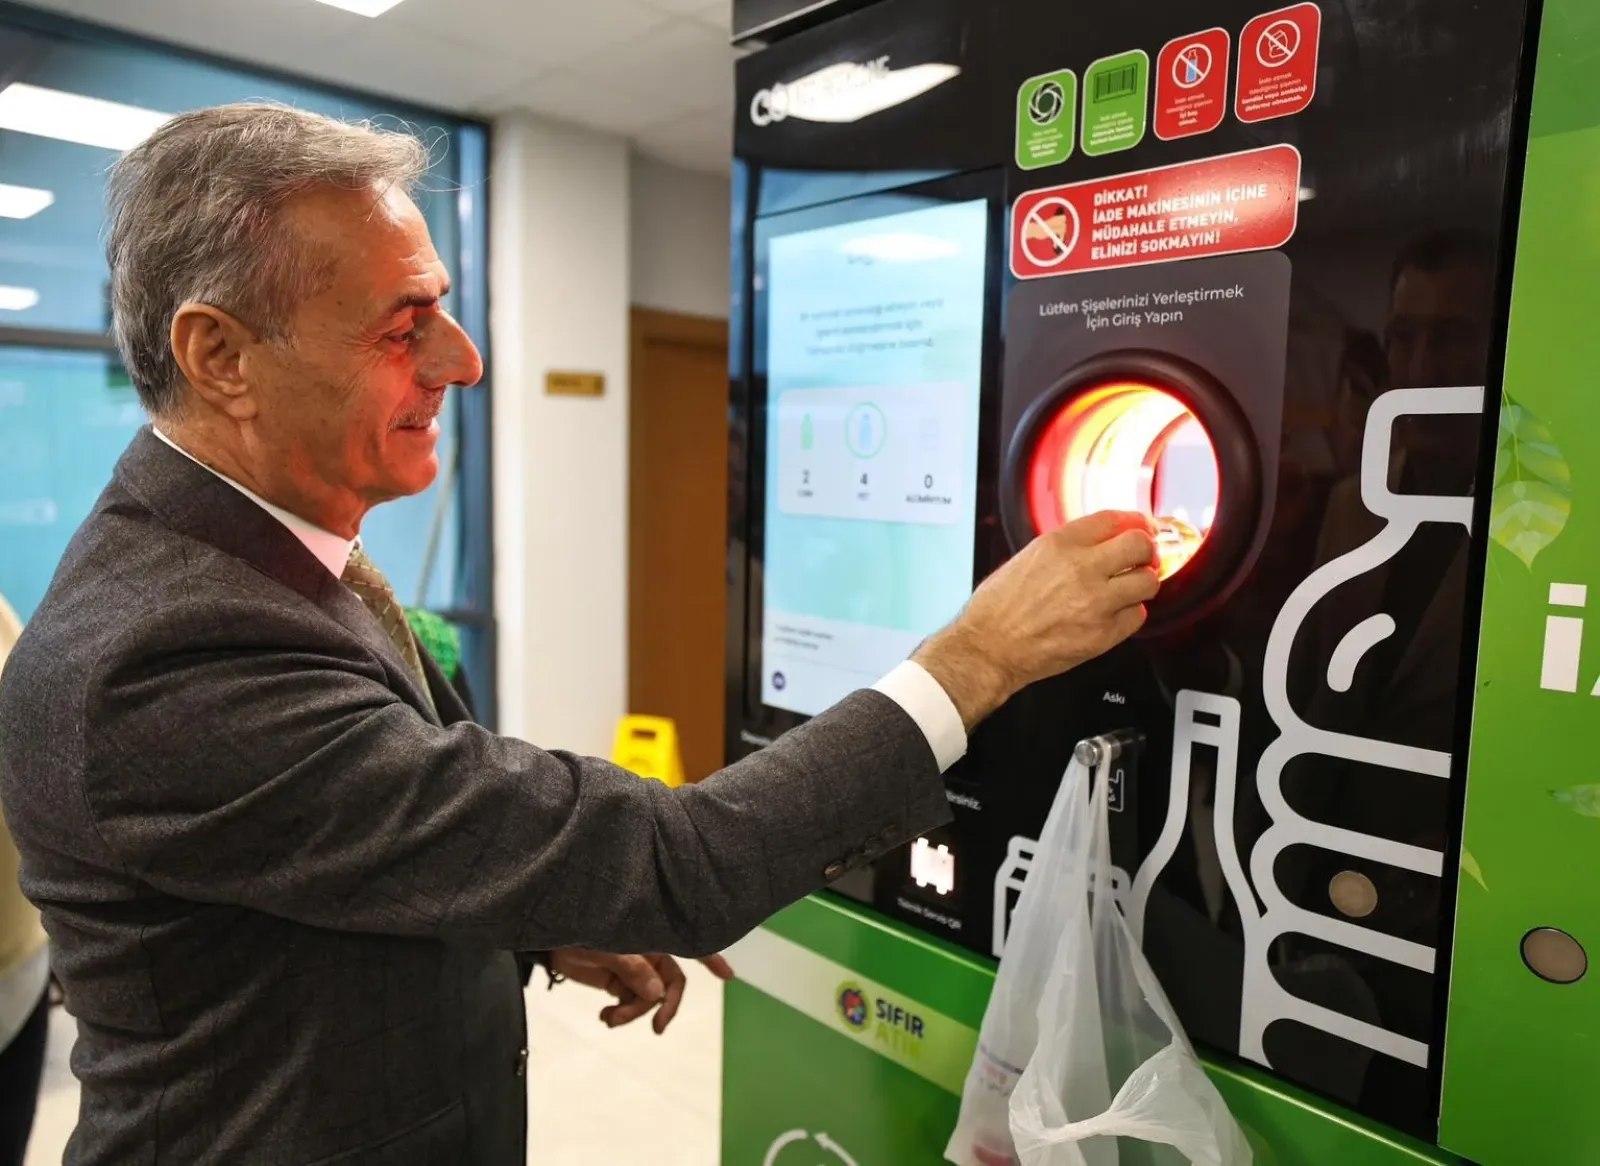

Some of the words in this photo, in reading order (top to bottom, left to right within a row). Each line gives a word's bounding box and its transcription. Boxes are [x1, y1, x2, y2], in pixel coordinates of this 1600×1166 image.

[1092, 207, 1123, 224] İADE
[1126, 191, 1222, 219] MAKİNESİNİN
[1225, 183, 1268, 204] İÇİNE
[1093, 184, 1148, 206] DİKKAT!
[1091, 219, 1165, 242] MÜDAHALE
[1091, 240, 1137, 260] ELİNİZİ
[1140, 230, 1221, 254] SOKMAYIN!
[1039, 301, 1079, 317] Lütfen
[1081, 292, 1150, 315] Şişelerinizi
[1152, 284, 1245, 306] Yerleştirmek
[1086, 313, 1110, 332] İçin
[1112, 311, 1142, 328] Giriş
[1144, 310, 1184, 325] Yapın
[860, 472, 868, 486] 4
[1102, 691, 1126, 705] Askı
[875, 997, 925, 1039] SIFIR
